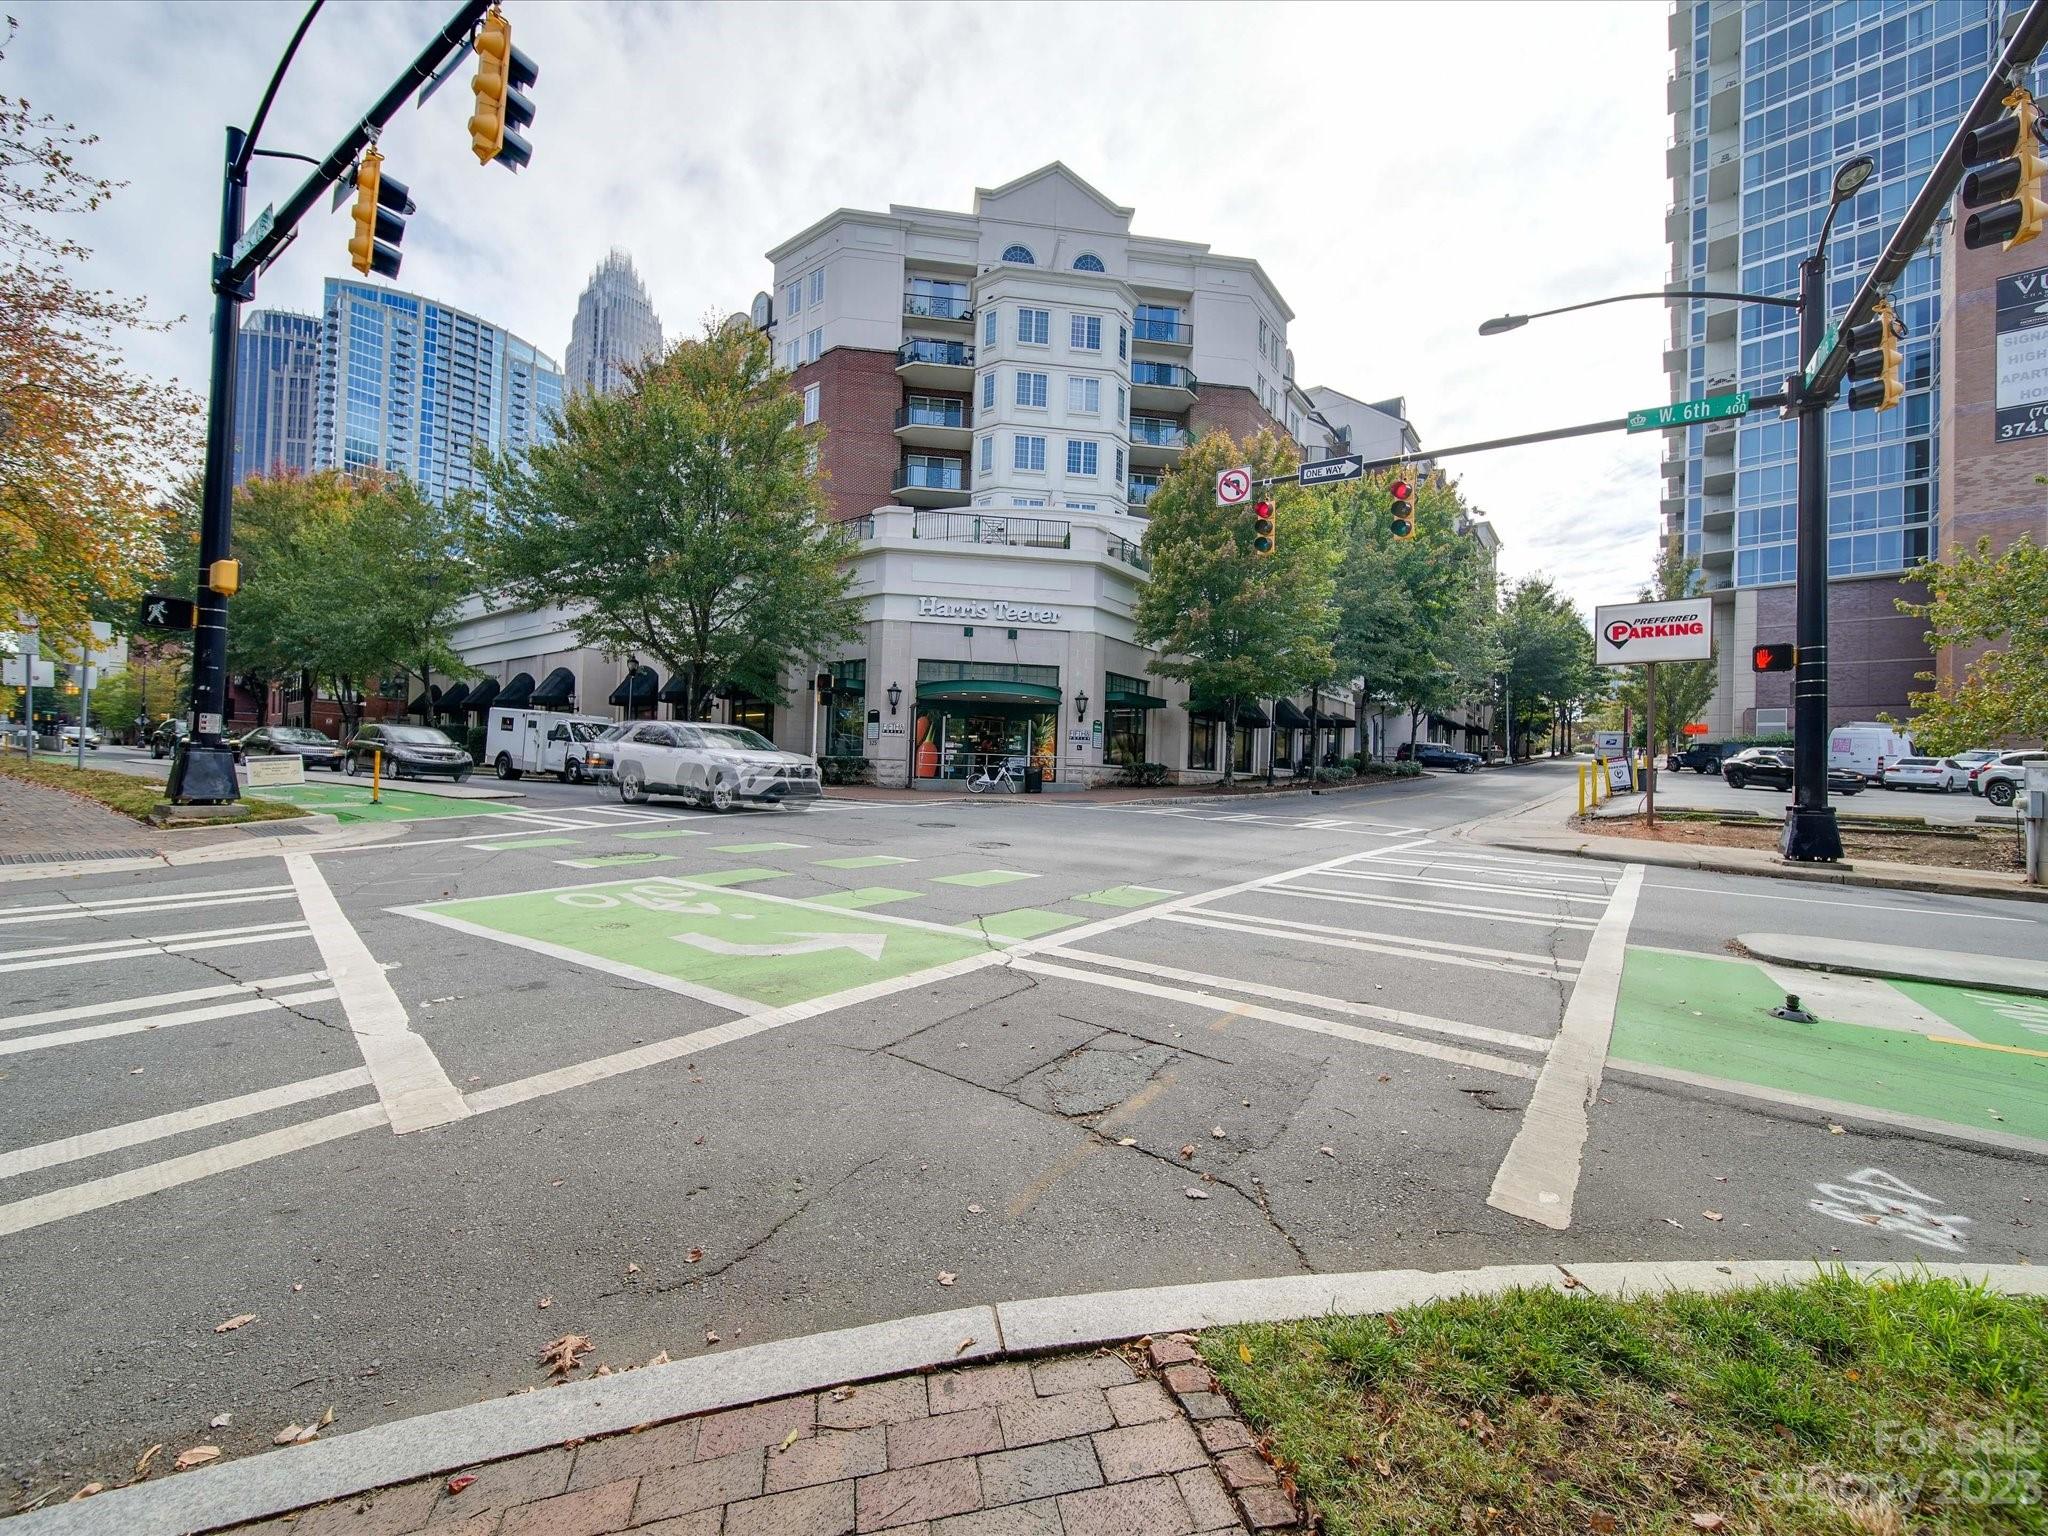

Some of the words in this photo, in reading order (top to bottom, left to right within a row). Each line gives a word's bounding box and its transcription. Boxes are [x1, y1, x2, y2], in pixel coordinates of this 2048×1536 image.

[1659, 407, 1676, 424] W.
[1684, 402, 1710, 419] 6th
[1735, 393, 1746, 405] St
[1725, 404, 1747, 415] 400
[1306, 468, 1323, 477] ONE
[1325, 465, 1343, 475] WAY
[918, 597, 988, 619] Harris
[993, 601, 1061, 624] Teeter
[1633, 614, 1698, 625] PREFERRED
[1613, 623, 1703, 640] PARKING
